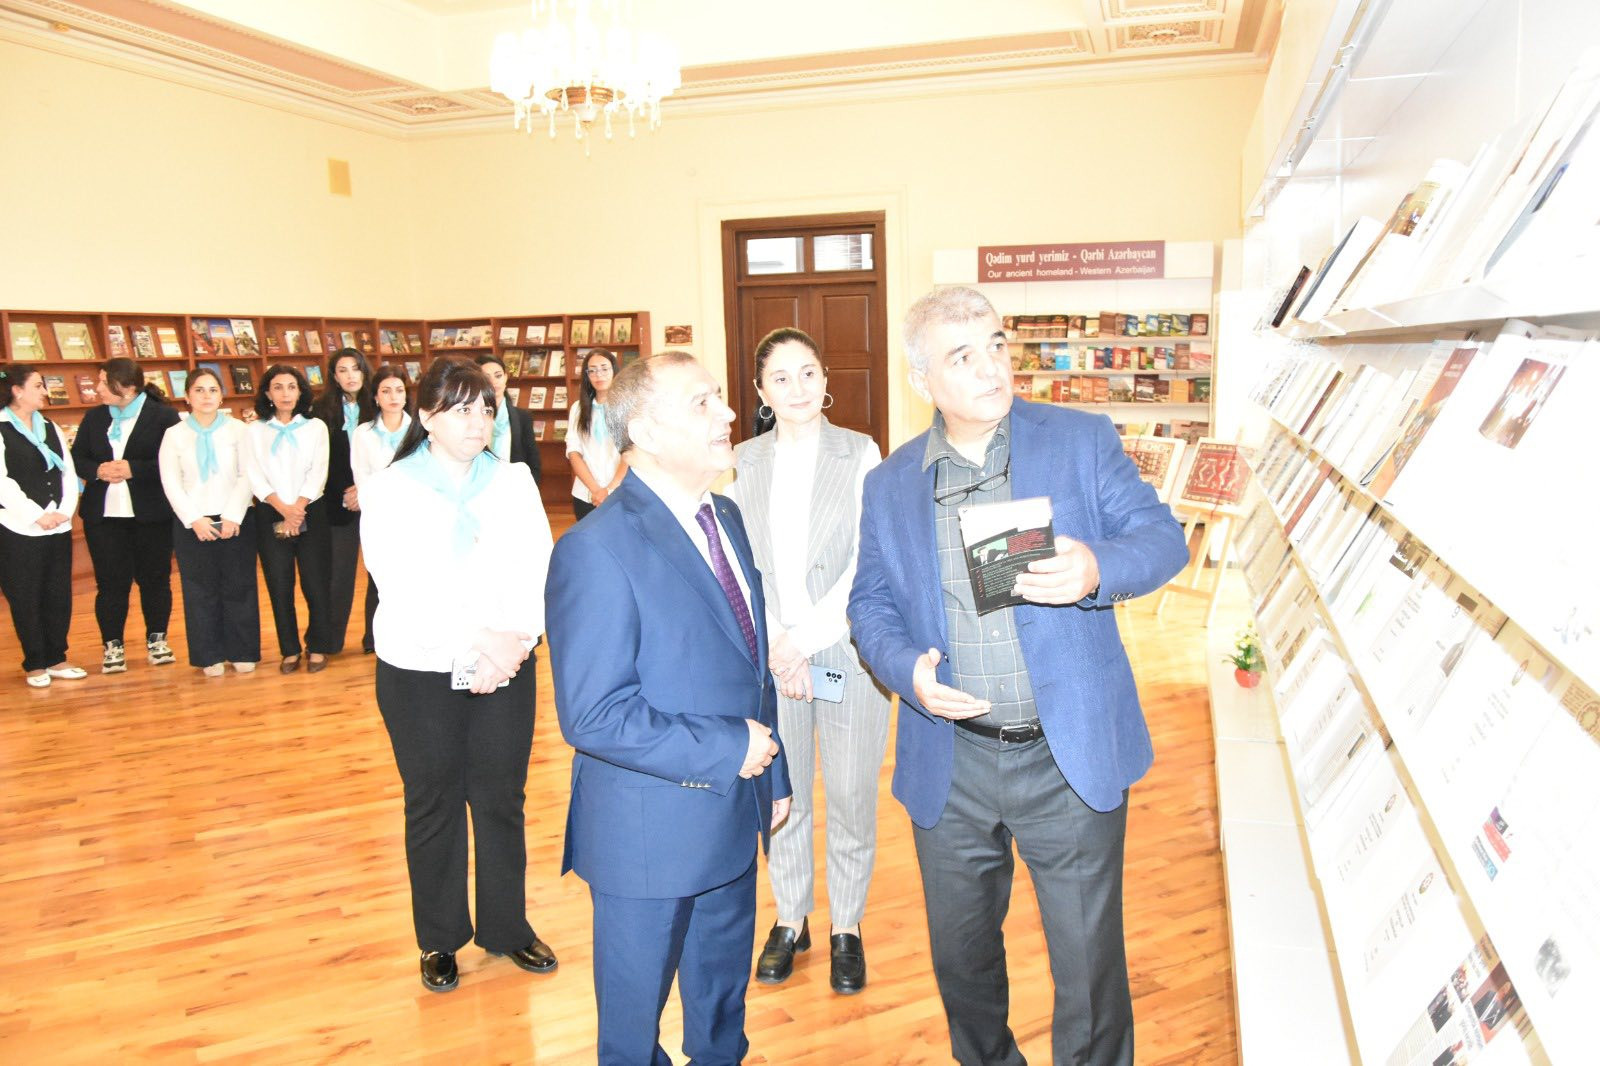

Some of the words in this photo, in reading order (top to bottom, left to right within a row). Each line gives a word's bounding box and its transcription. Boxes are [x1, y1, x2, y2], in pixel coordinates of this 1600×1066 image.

[985, 252, 1013, 267] Qədim
[1015, 250, 1035, 266] yurd
[1039, 249, 1069, 265] yerimiz
[1080, 248, 1104, 263] Qərbi
[1108, 247, 1156, 262] Azərbaycan
[987, 270, 1002, 278] Our
[1005, 269, 1033, 278] ancient
[1036, 267, 1074, 276] homeland
[1080, 266, 1112, 275] Western
